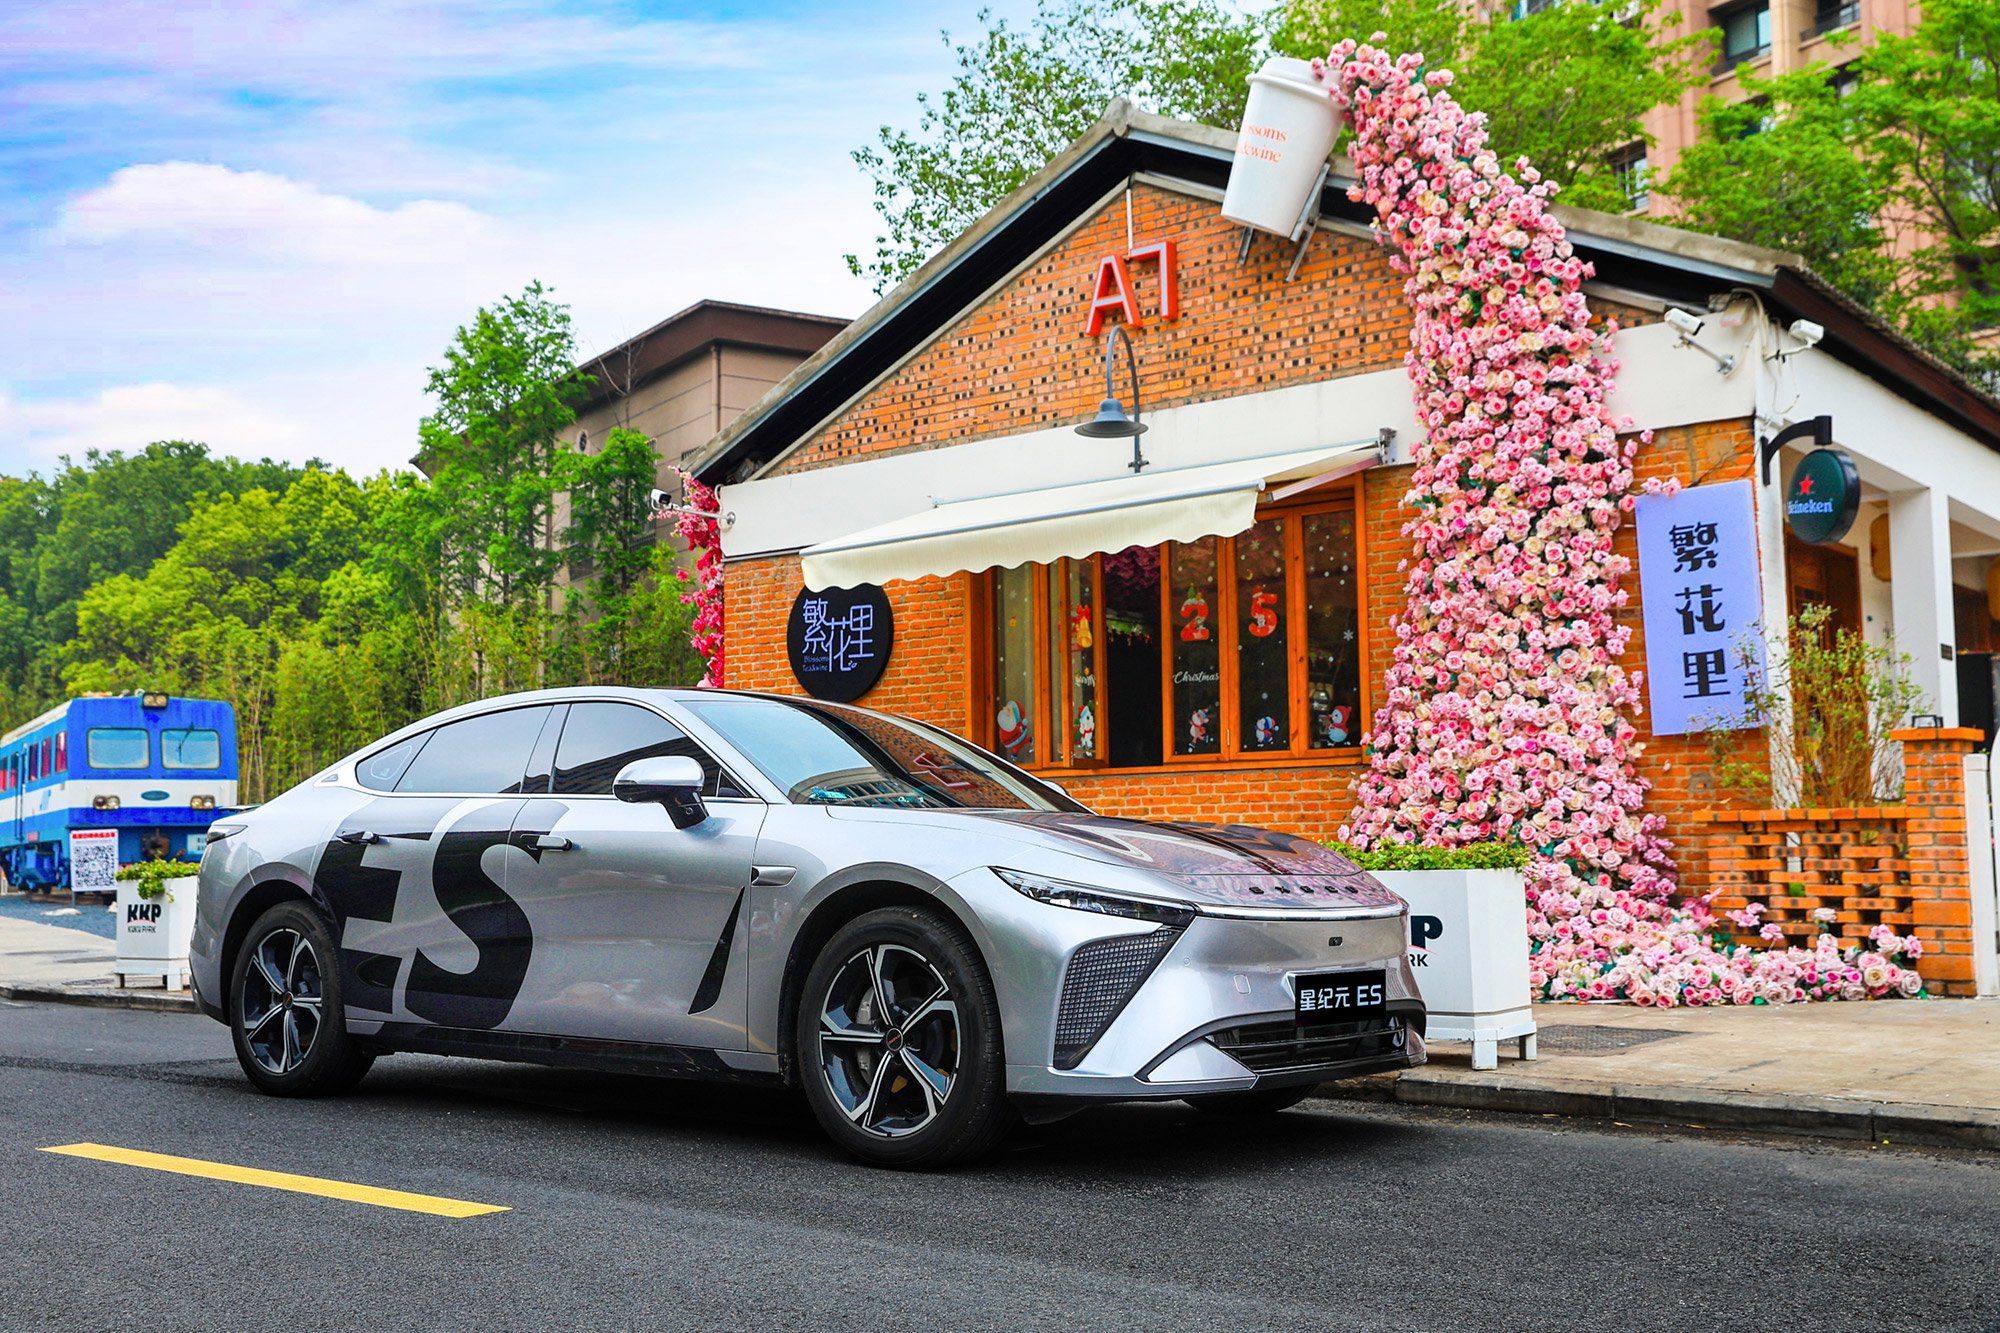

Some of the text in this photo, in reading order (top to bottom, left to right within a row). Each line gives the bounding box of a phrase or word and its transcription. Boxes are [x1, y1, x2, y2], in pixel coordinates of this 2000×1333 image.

[1248, 125, 1288, 142] ssoms
[1669, 521, 1731, 699] 繁花里
[801, 597, 875, 673] 繁花里
[1172, 670, 1220, 684] Christmas
[127, 904, 162, 923] KKP
[311, 796, 570, 1030] ES
[1409, 953, 1429, 968] RK
[1300, 984, 1382, 1011] 星纪元 ES
